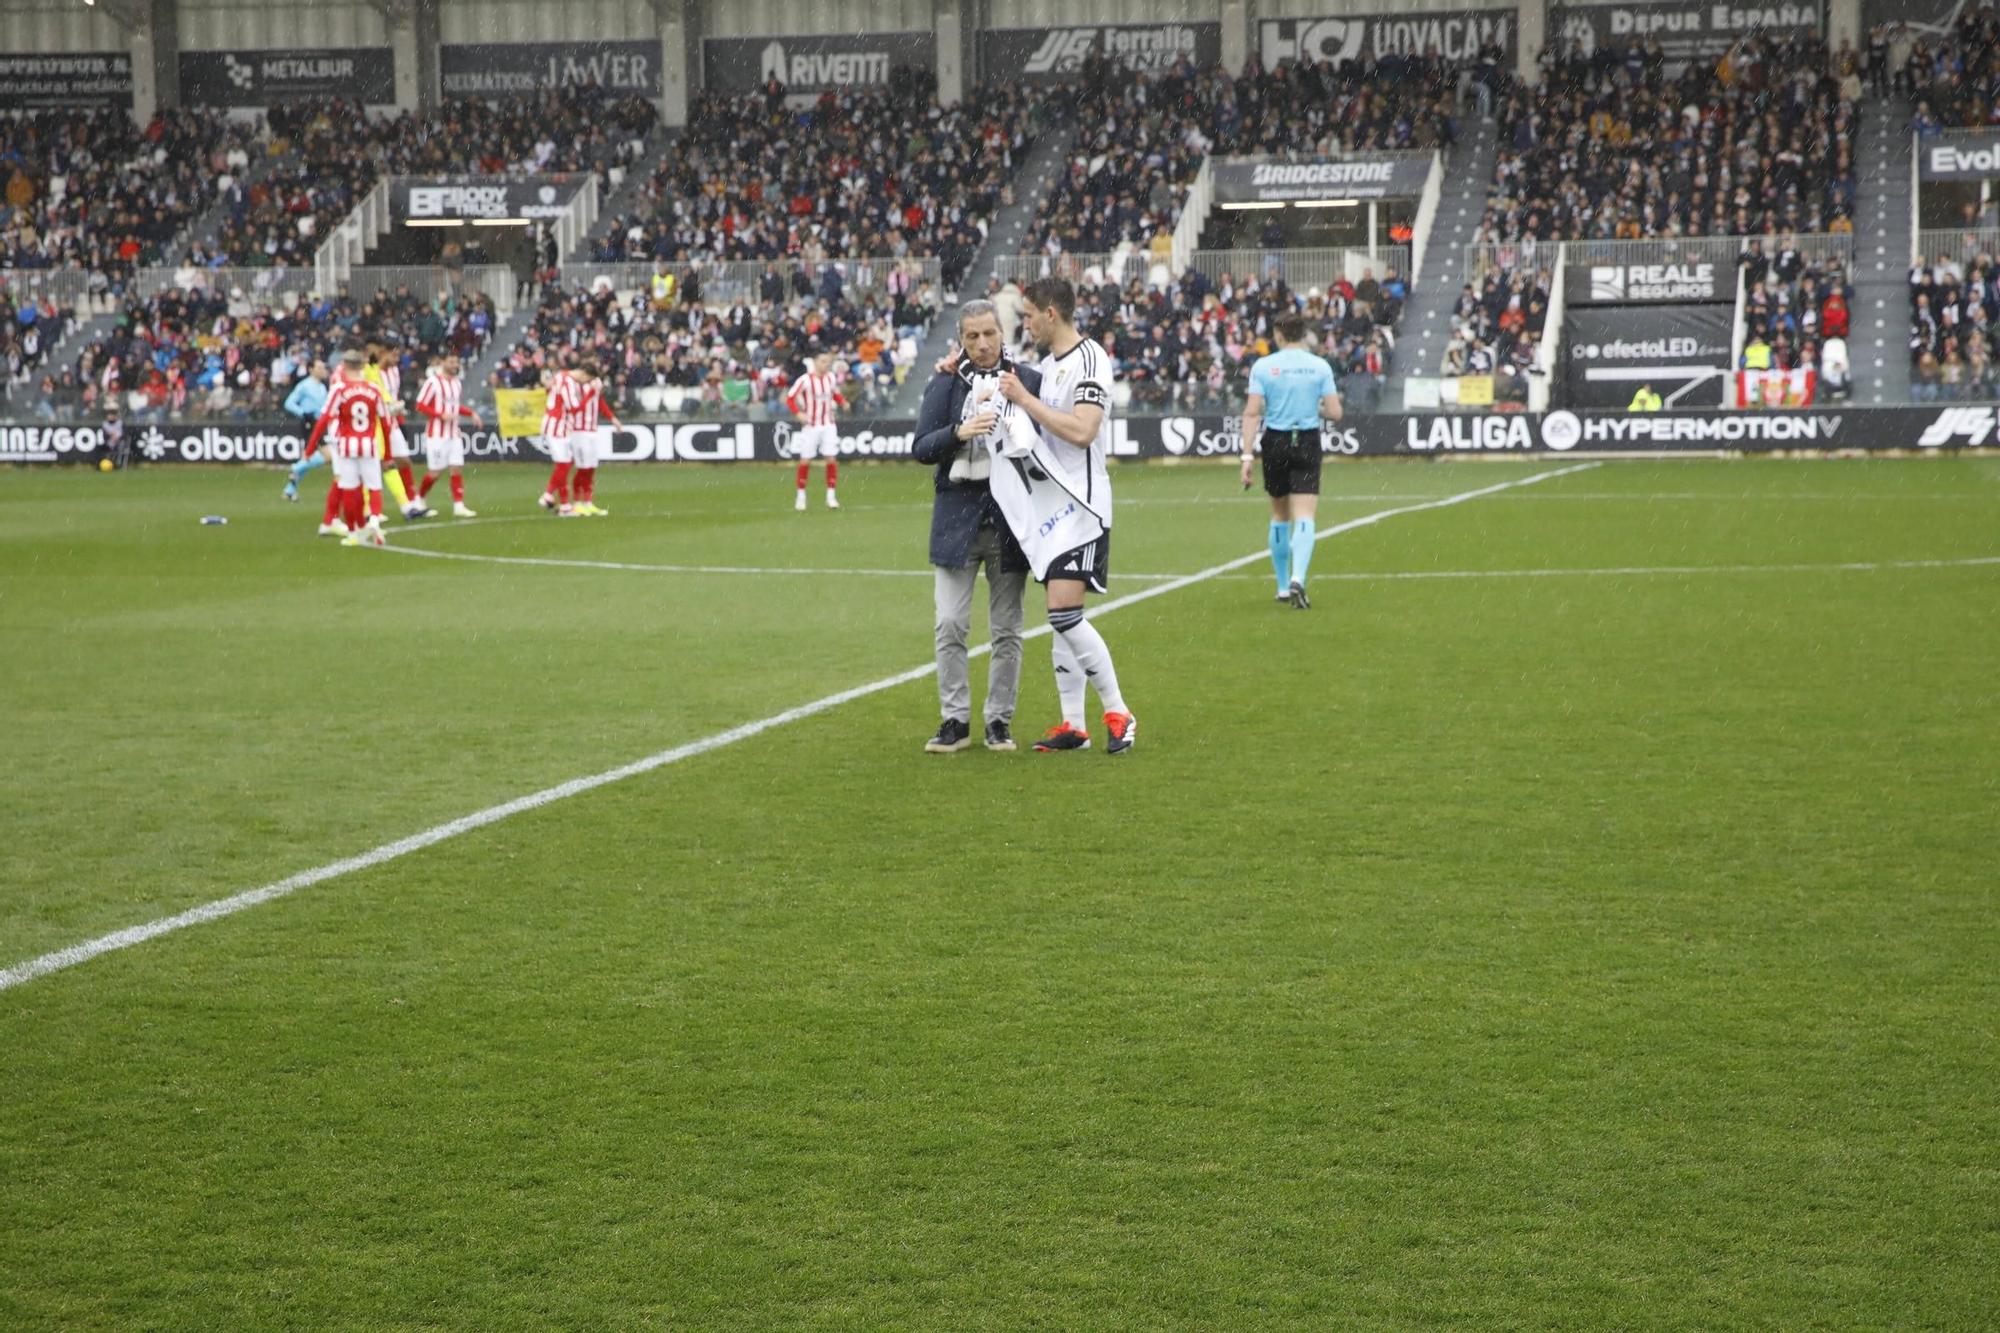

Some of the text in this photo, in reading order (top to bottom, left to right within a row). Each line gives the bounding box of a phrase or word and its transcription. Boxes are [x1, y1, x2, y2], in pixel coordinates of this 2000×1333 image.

[1932, 142, 2000, 172] Evol
[1252, 162, 1394, 185] BRIDGESTONE
[1628, 263, 1714, 283] REALE
[1628, 283, 1714, 299] SEGUROS
[1602, 338, 1698, 359] efectoLED
[350, 401, 370, 433] 8
[598, 424, 755, 460] DIGI
[1408, 416, 1533, 449] LALIGA
[1039, 502, 1075, 538] DIGI
